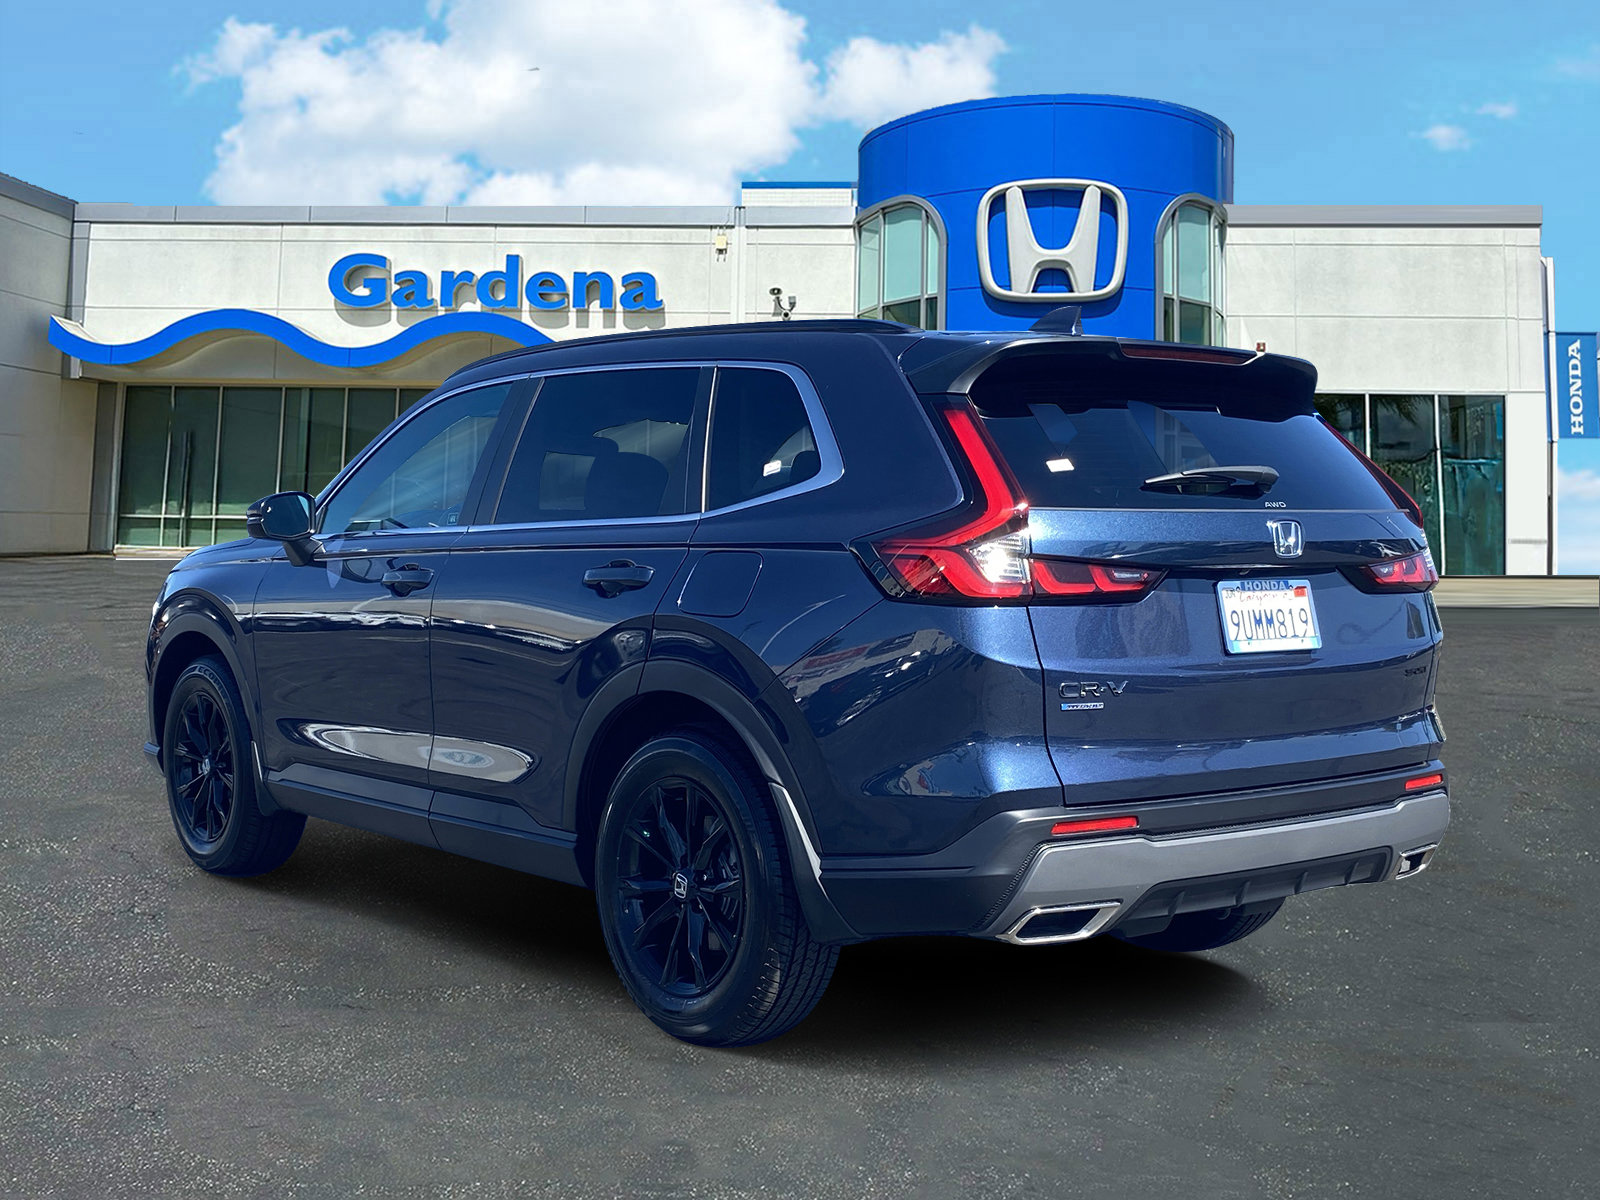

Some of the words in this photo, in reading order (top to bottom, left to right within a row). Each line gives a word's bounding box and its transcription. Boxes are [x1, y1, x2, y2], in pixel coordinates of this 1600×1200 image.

[328, 253, 663, 309] Gardena
[1568, 339, 1584, 435] HONDA
[1244, 581, 1287, 591] HONDA
[1230, 608, 1309, 640] 9UMM819
[1060, 680, 1129, 698] CR-V
